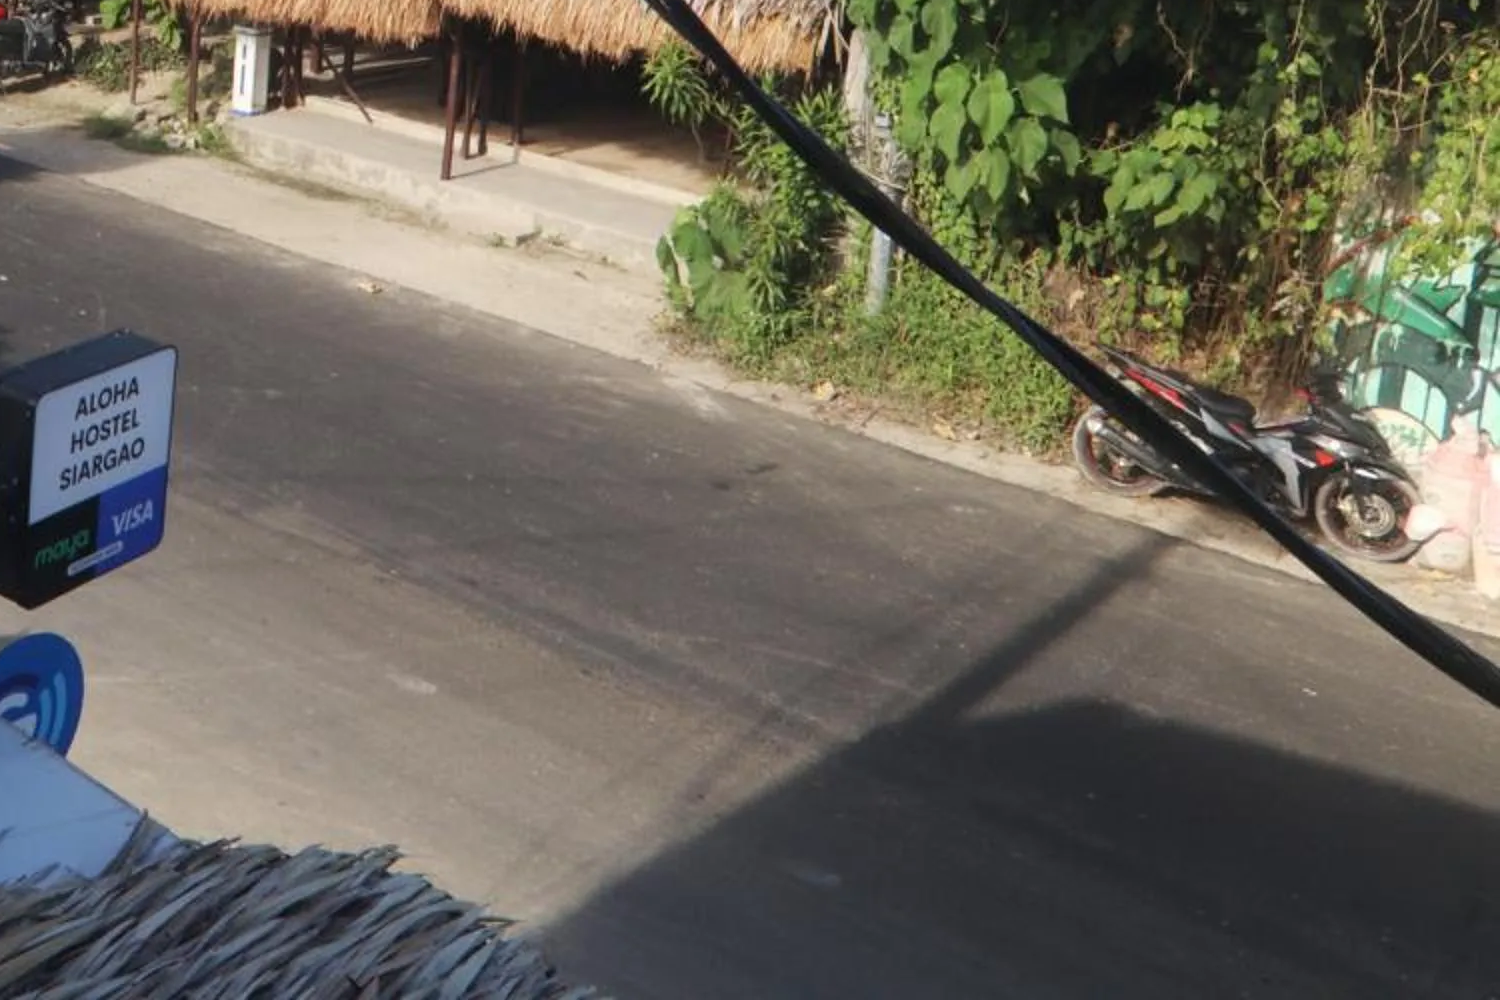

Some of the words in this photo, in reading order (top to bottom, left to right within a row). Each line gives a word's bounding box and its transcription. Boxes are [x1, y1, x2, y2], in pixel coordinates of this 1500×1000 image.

[75, 376, 140, 421] ALOHA
[70, 408, 140, 454] HOSTEL
[58, 437, 146, 491] SIARGAO
[111, 498, 154, 537] VISA
[34, 528, 90, 569] maya
